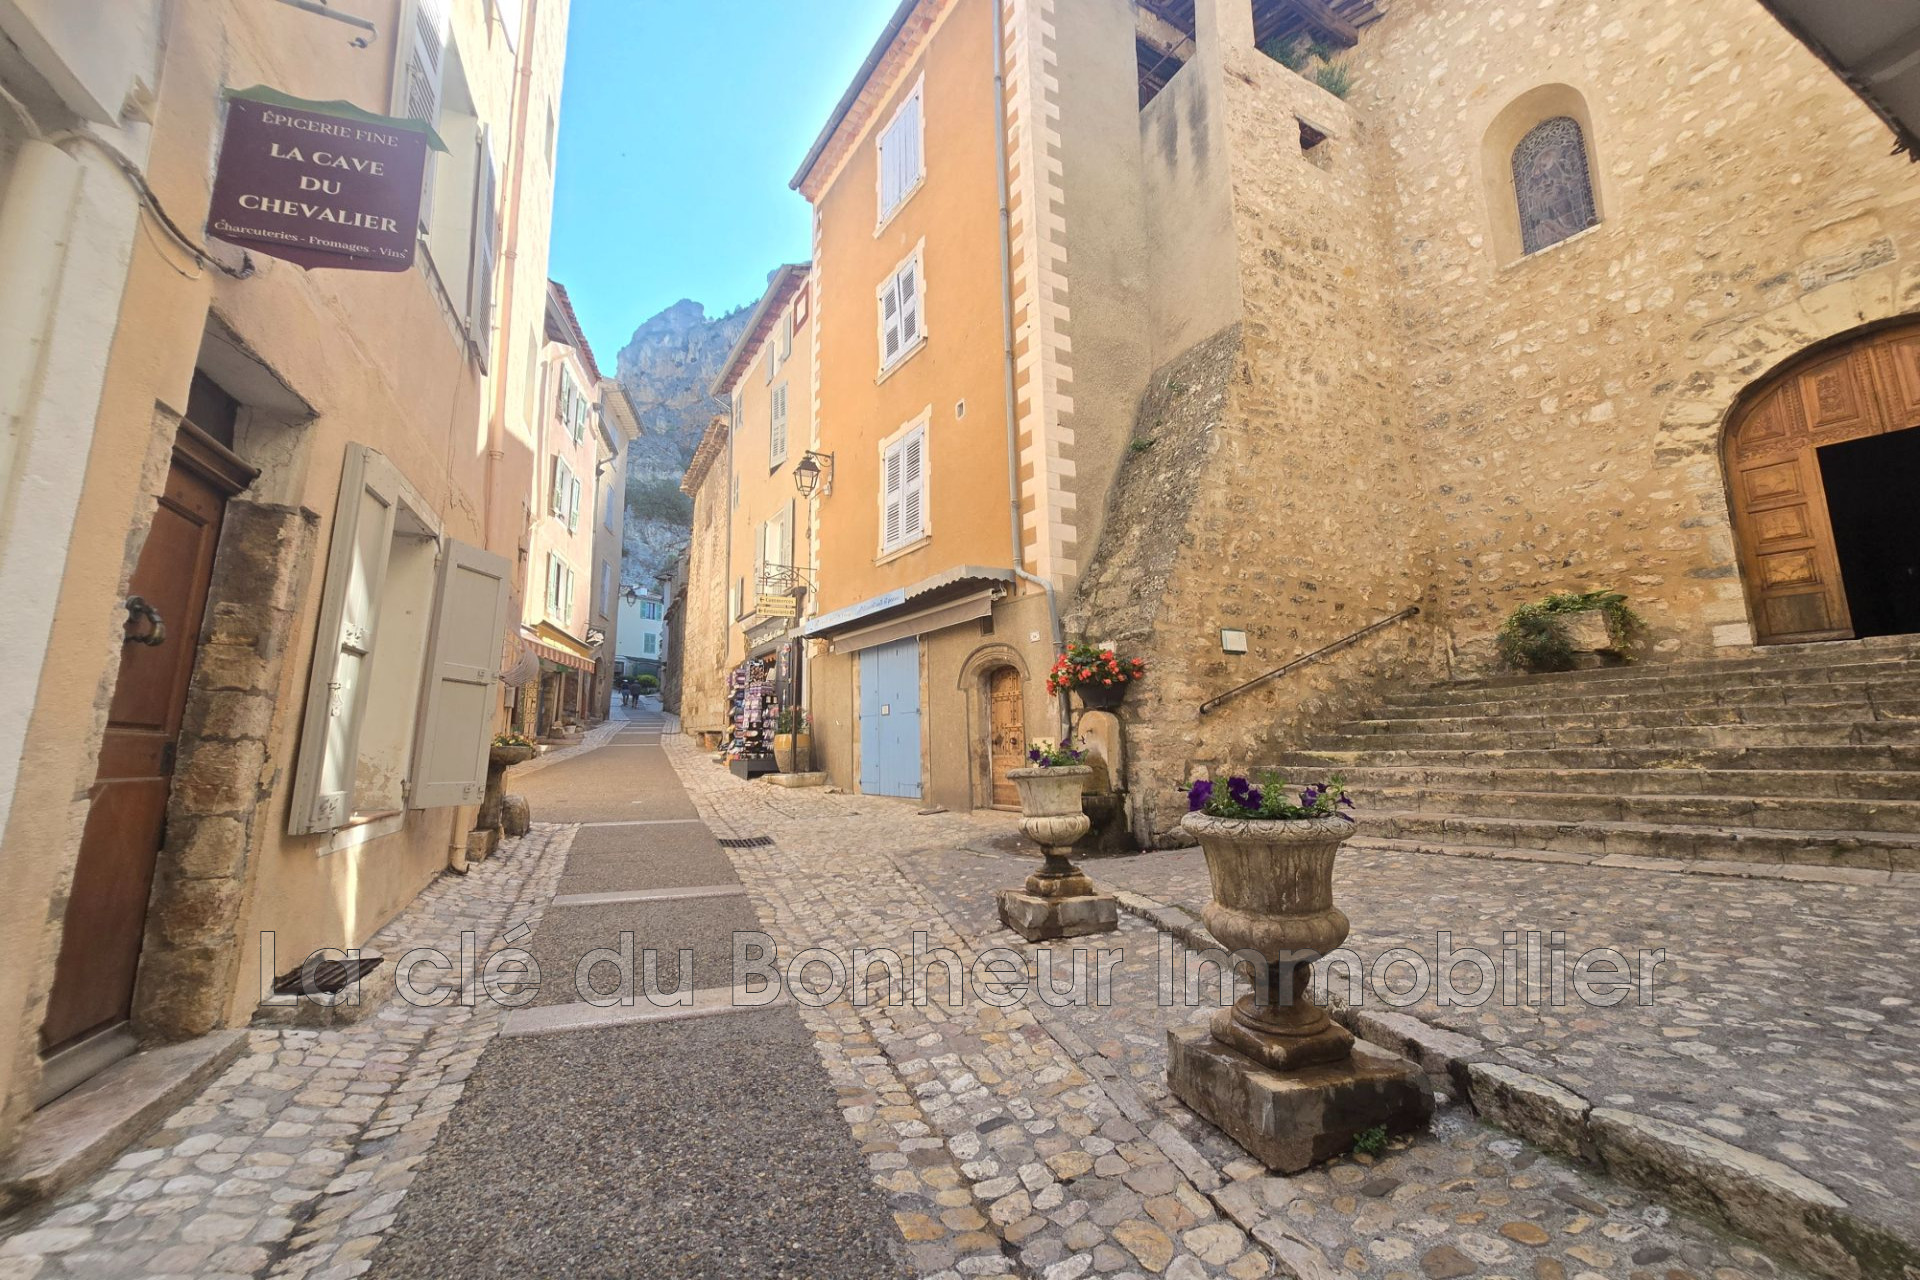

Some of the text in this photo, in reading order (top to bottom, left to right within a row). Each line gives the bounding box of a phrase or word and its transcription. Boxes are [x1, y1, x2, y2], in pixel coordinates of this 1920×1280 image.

[356, 129, 399, 147] FINE
[270, 142, 384, 176] LA CAVE
[300, 175, 341, 195] DU
[238, 194, 399, 234] CHEVALIER
[214, 221, 298, 242] Charcuteries
[309, 236, 369, 253] Fromages
[379, 247, 406, 259] Vins
